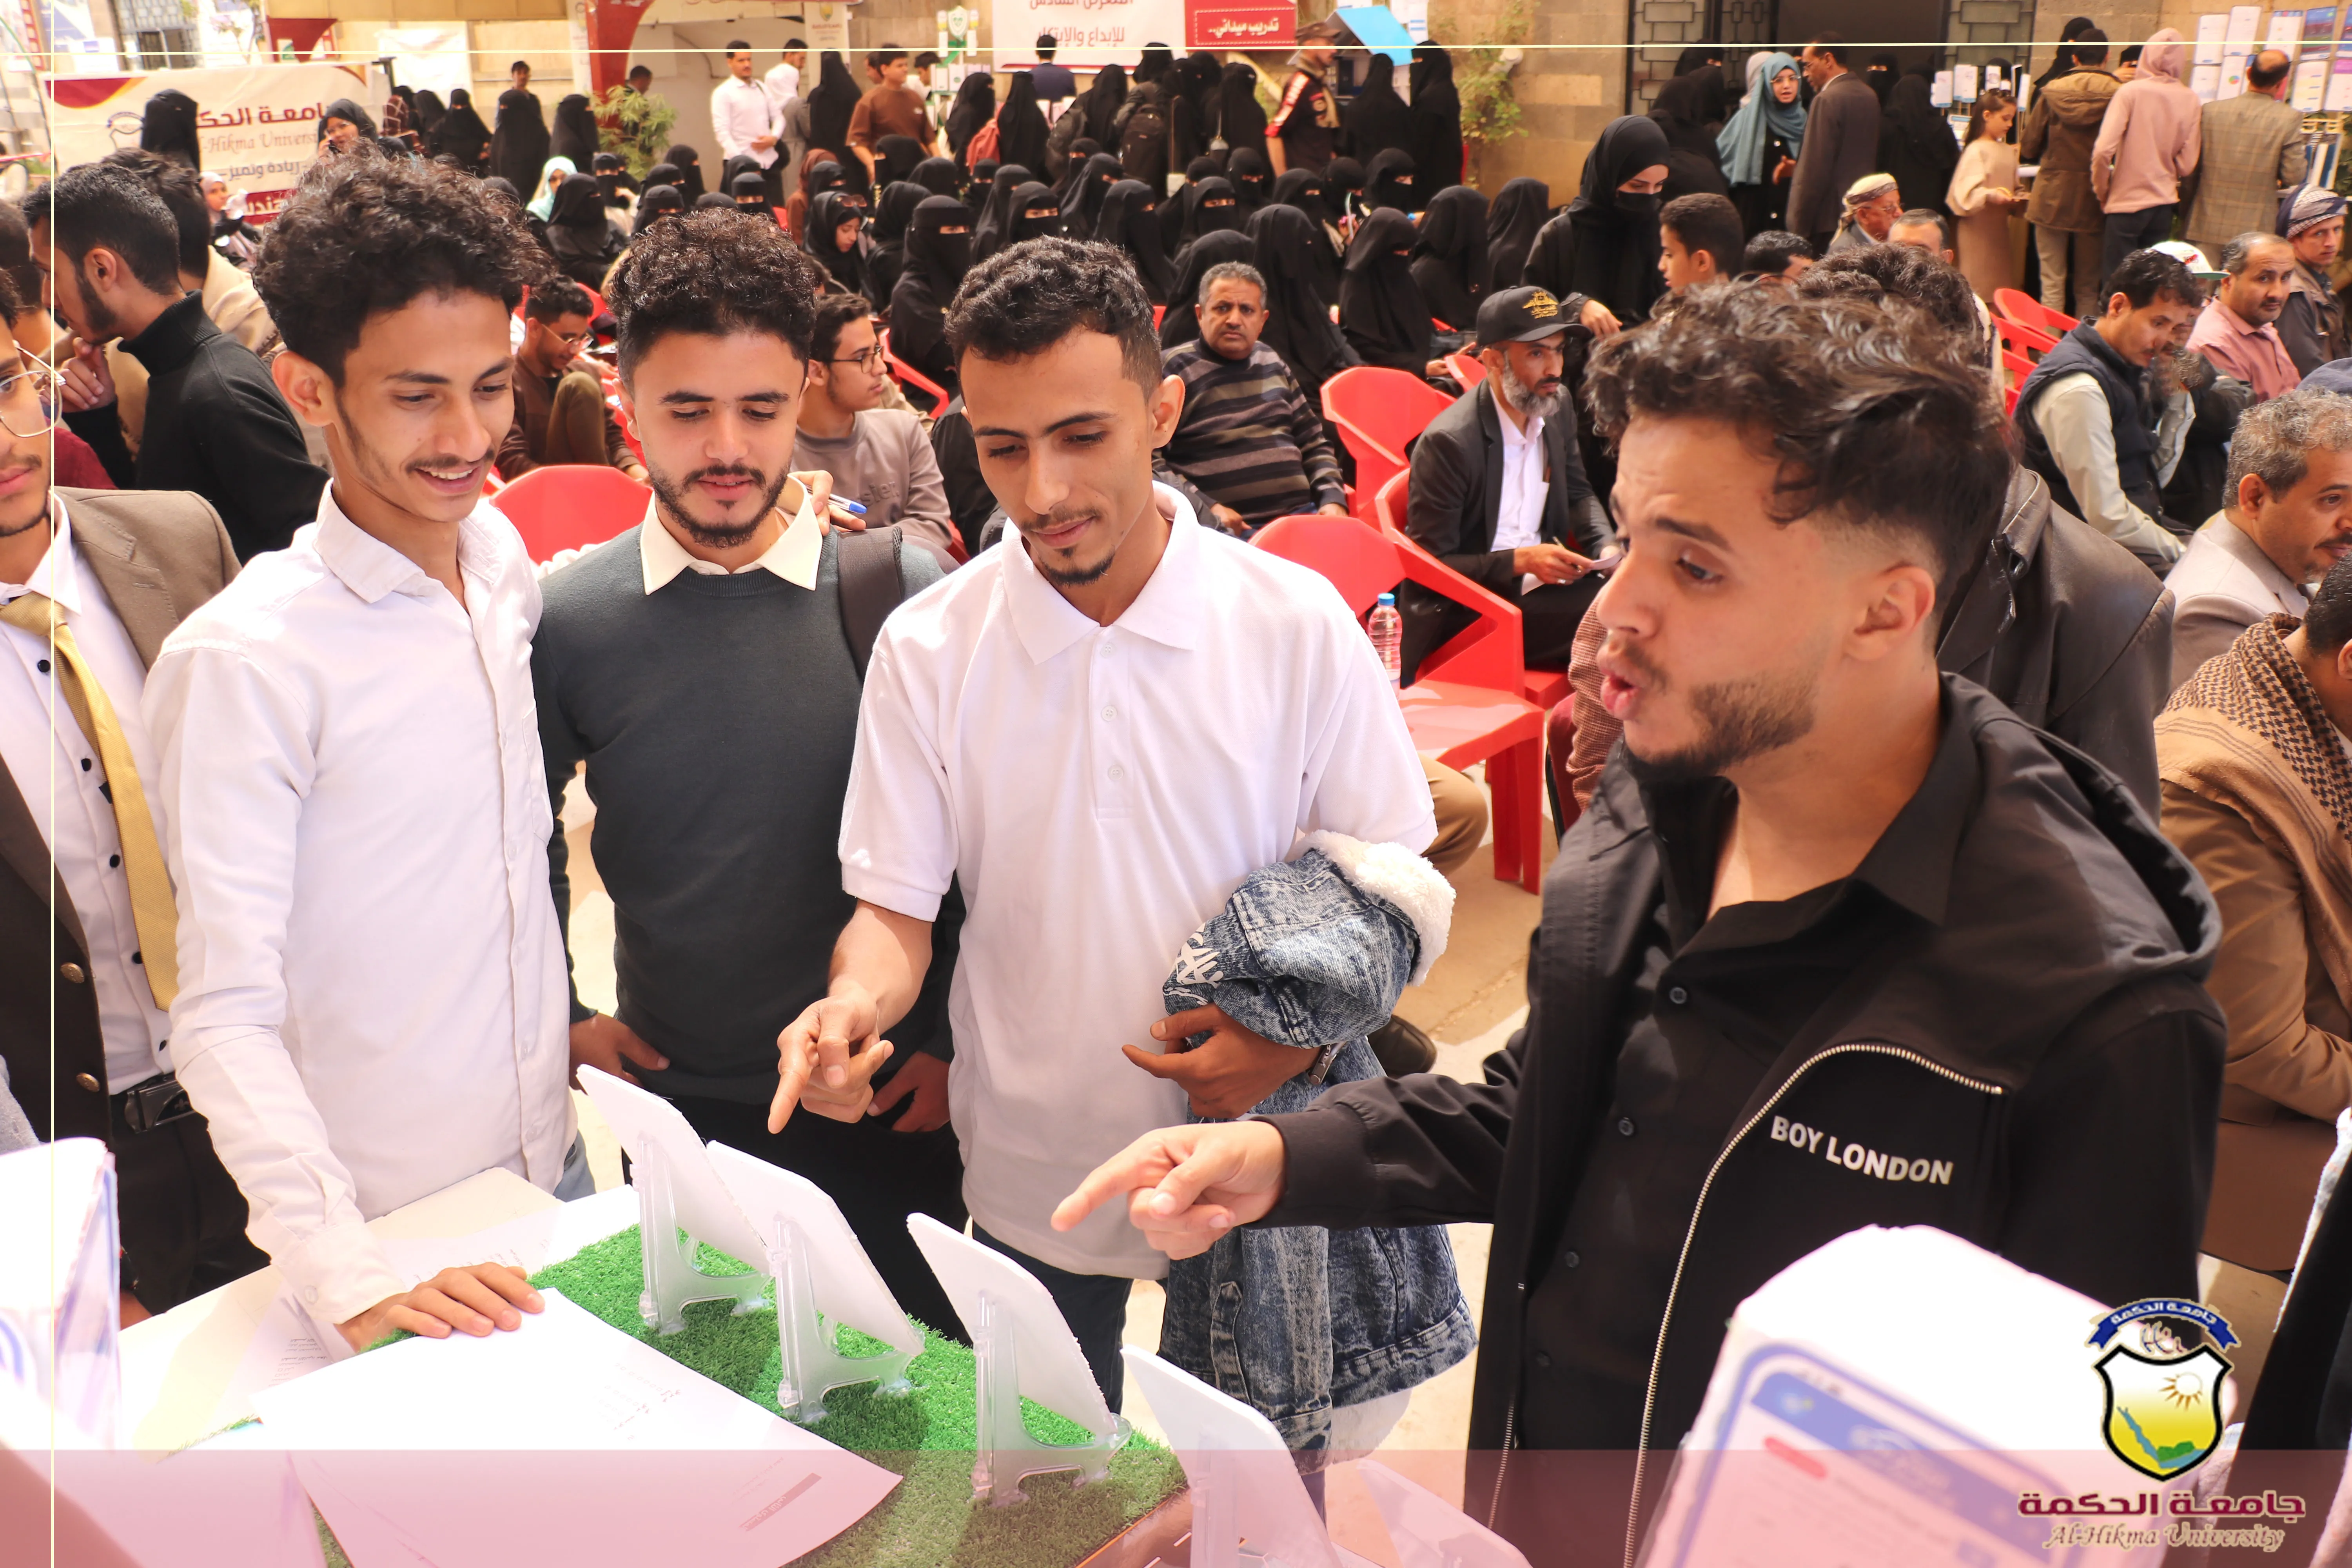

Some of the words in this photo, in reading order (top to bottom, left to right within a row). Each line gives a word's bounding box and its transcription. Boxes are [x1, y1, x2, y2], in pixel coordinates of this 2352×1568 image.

[1248, 18, 1279, 36] تدريب
[196, 107, 252, 129] الحك
[258, 102, 328, 125] امعة
[1771, 1115, 1824, 1154] BOY
[1826, 1136, 1954, 1185] LONDON
